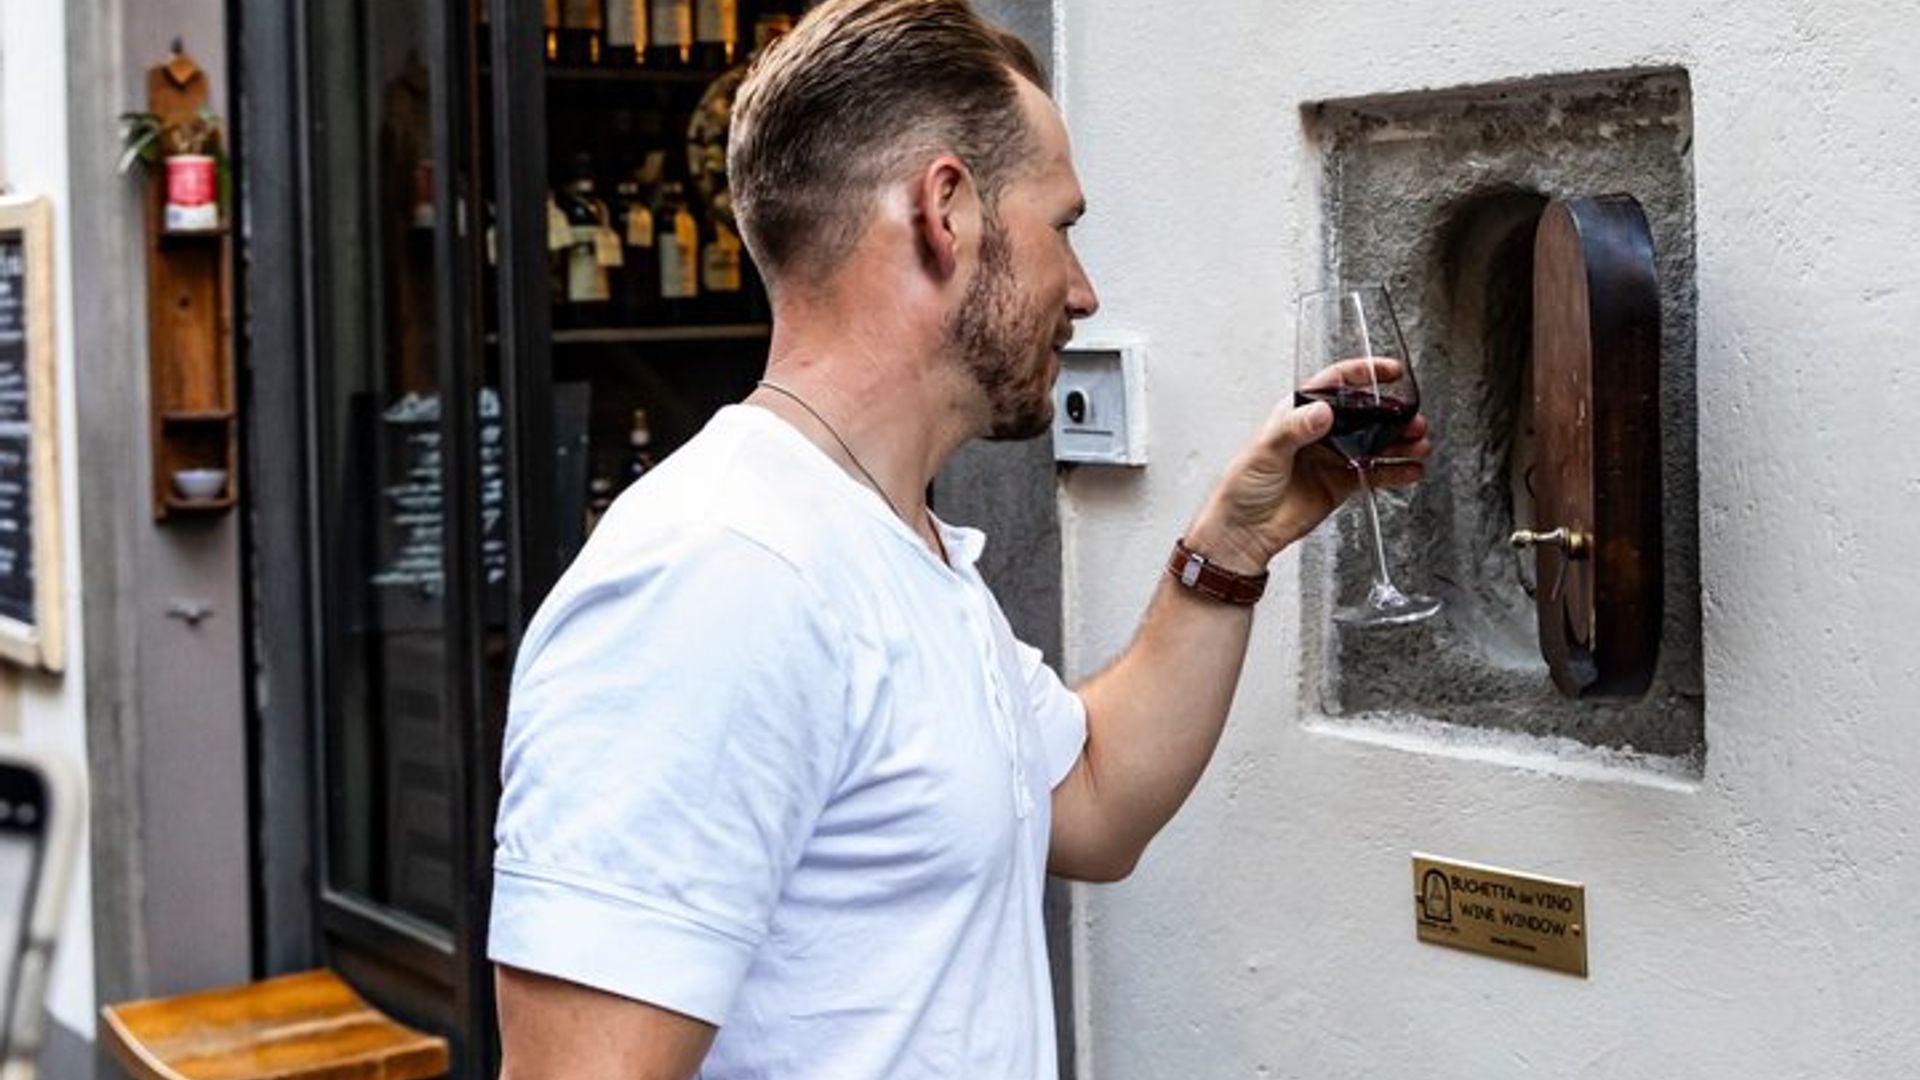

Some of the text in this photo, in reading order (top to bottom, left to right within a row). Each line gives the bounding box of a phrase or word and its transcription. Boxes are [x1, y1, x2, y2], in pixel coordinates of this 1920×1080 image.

[1451, 875, 1516, 900] BUCHETTA
[1536, 892, 1572, 913] VINO
[1459, 902, 1566, 937] WINE WINDOW
